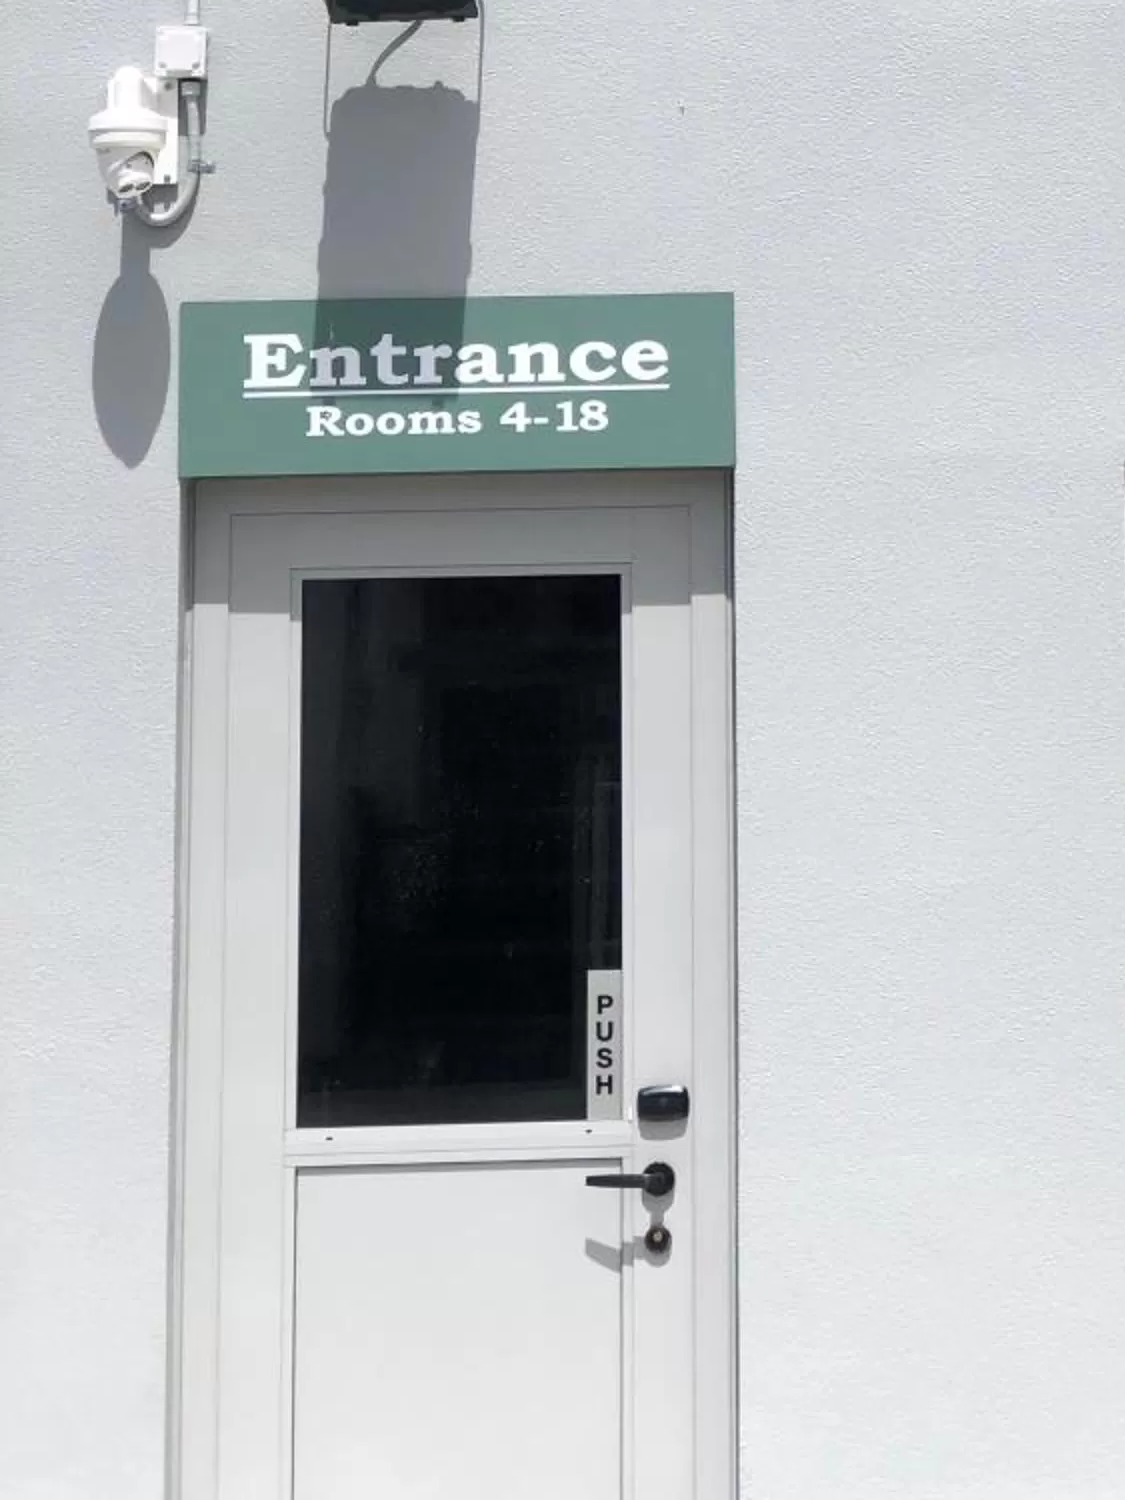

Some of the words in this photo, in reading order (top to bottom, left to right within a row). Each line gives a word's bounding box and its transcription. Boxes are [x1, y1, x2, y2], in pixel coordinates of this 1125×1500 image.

[242, 332, 670, 389] Entrance
[305, 405, 482, 437] Rooms
[500, 401, 609, 433] 4-18
[596, 995, 614, 1095] PUSH
